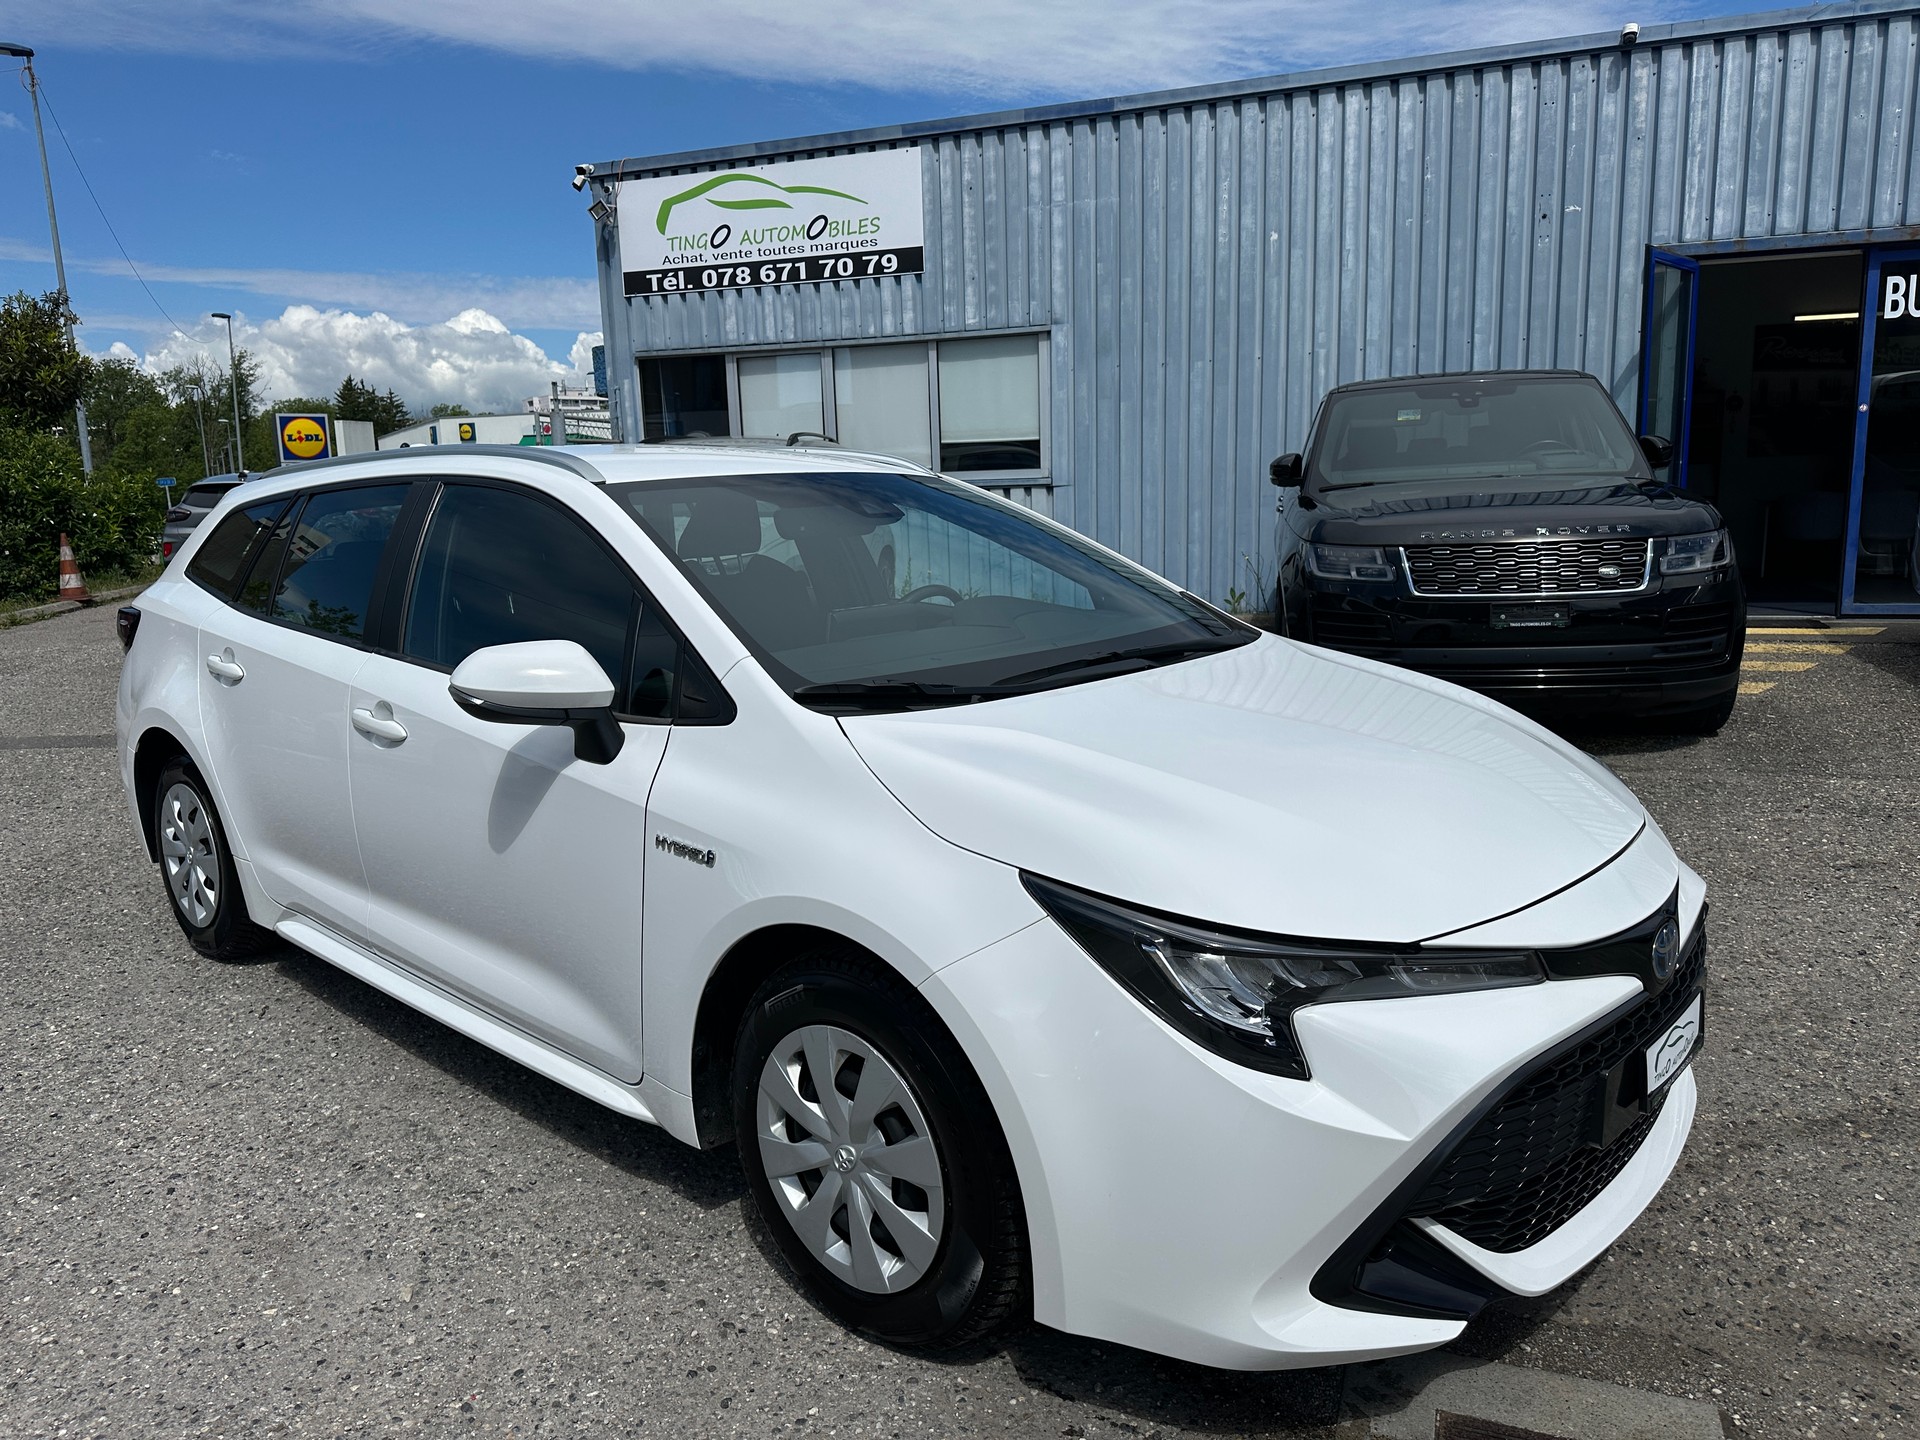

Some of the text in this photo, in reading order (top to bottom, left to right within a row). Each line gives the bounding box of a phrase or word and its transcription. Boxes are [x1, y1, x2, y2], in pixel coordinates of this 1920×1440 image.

[667, 214, 881, 252] TINGO AUTOMOBILES
[662, 238, 878, 266] Achat, vente toutes marques
[646, 253, 898, 292] Tél. 078 671 70 79
[1420, 524, 1631, 540] RANGE ROVER
[655, 833, 706, 866] HYBRID
